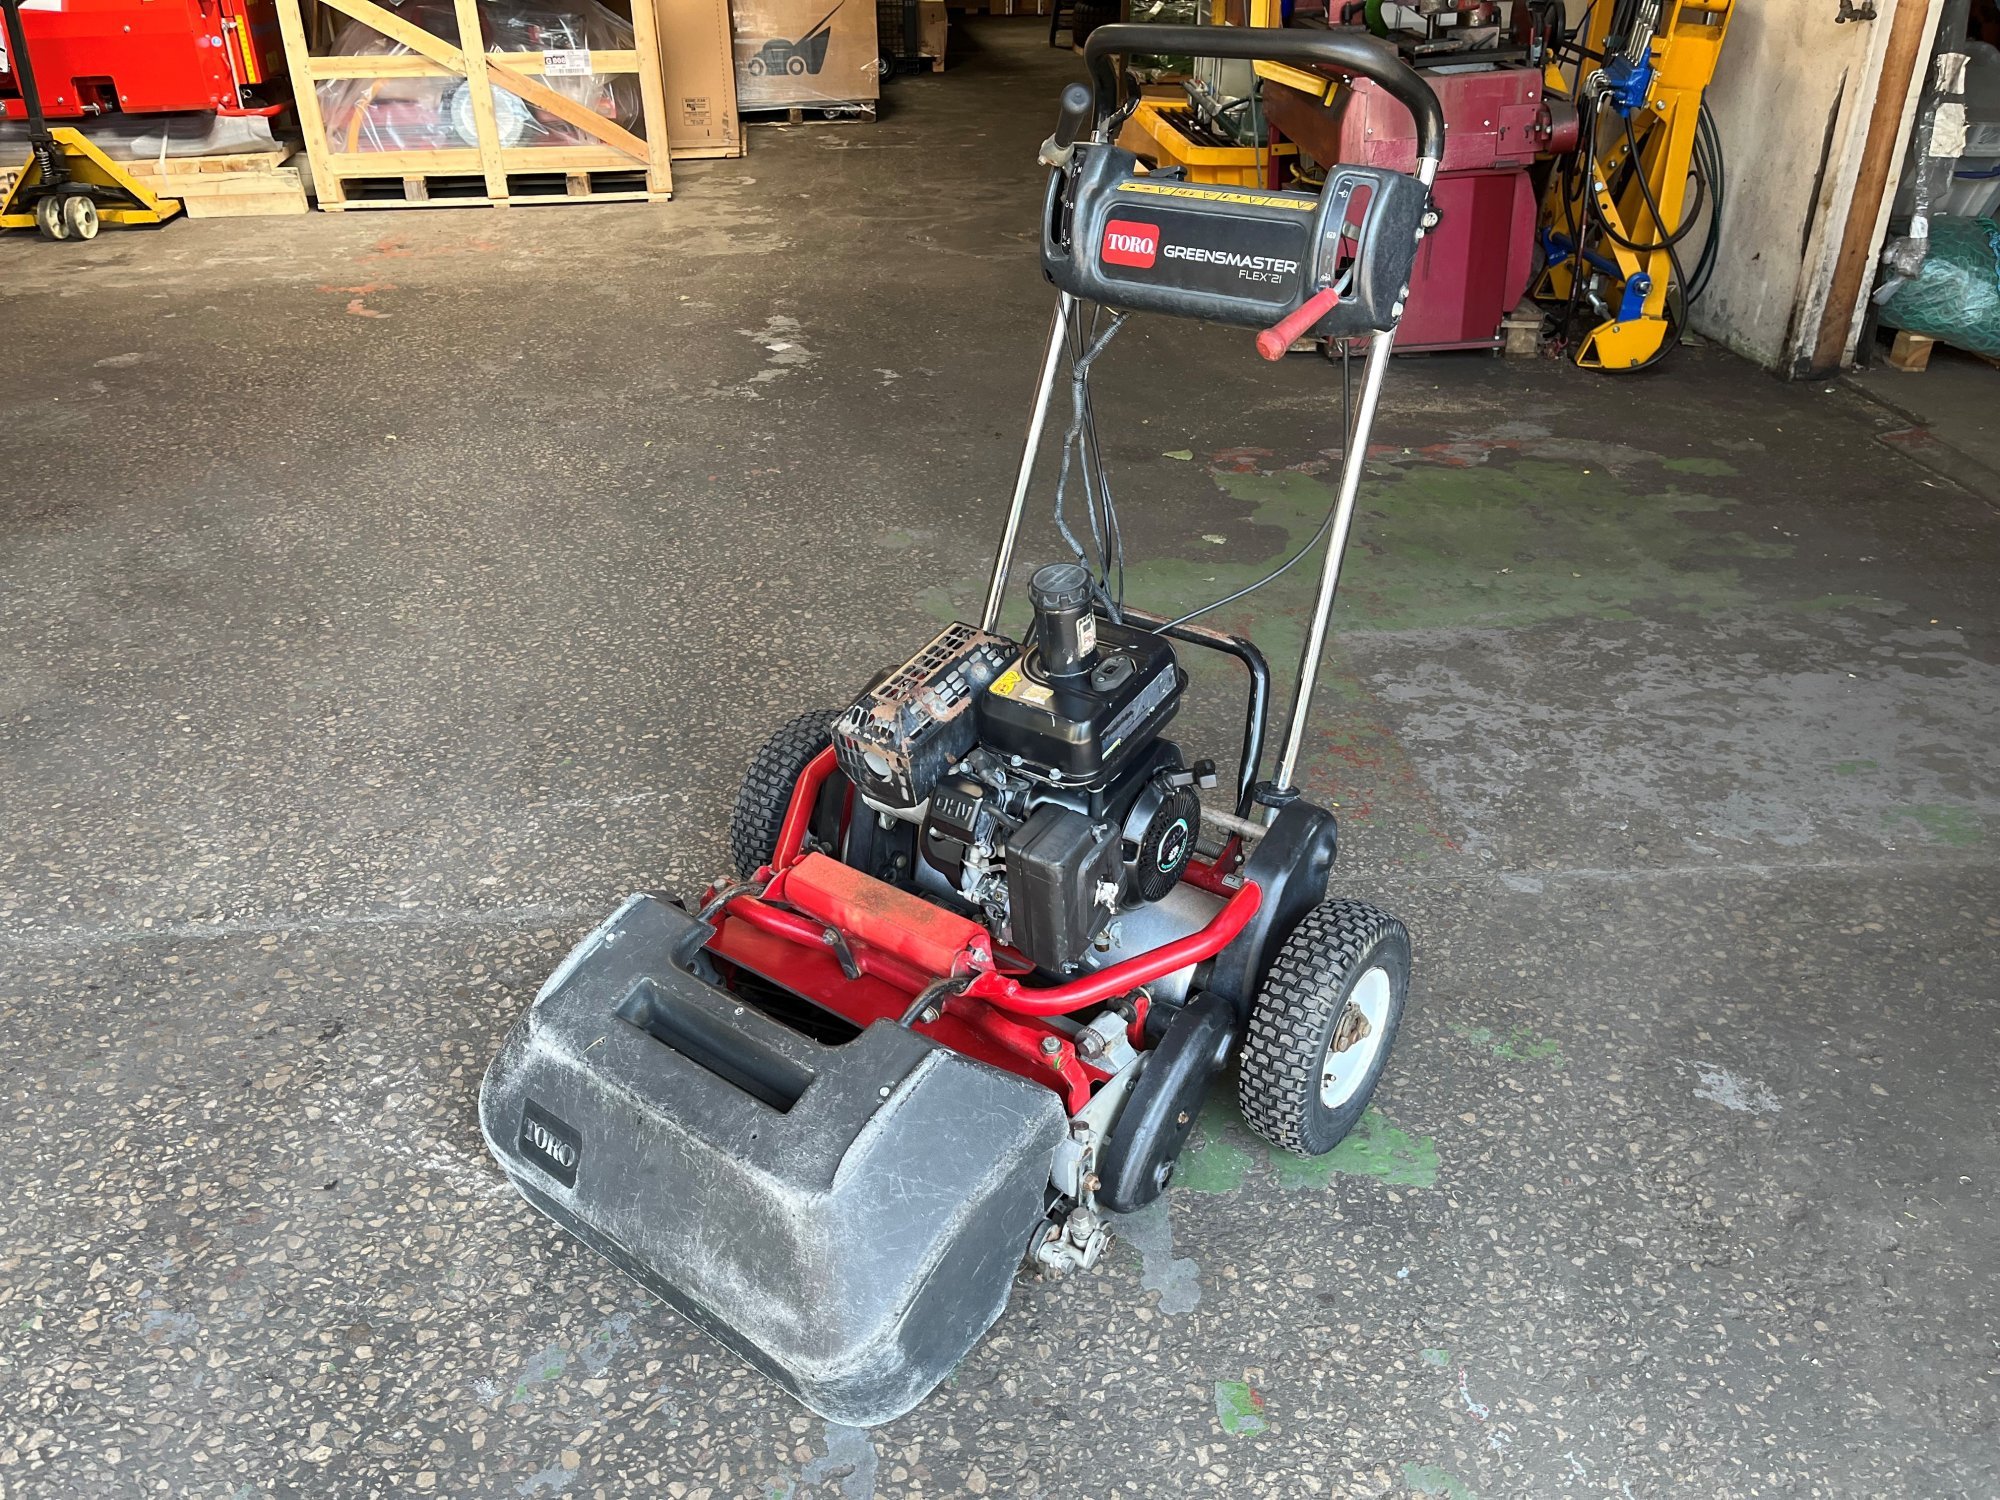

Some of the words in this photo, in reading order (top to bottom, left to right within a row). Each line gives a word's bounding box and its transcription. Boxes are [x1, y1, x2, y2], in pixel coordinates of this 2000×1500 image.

[1108, 233, 1154, 255] TORO
[1163, 244, 1298, 274] GREENSMASTER
[1238, 269, 1268, 282] FLEX
[1270, 273, 1282, 284] 21
[935, 796, 973, 821] OHV
[523, 1117, 576, 1168] TORO
